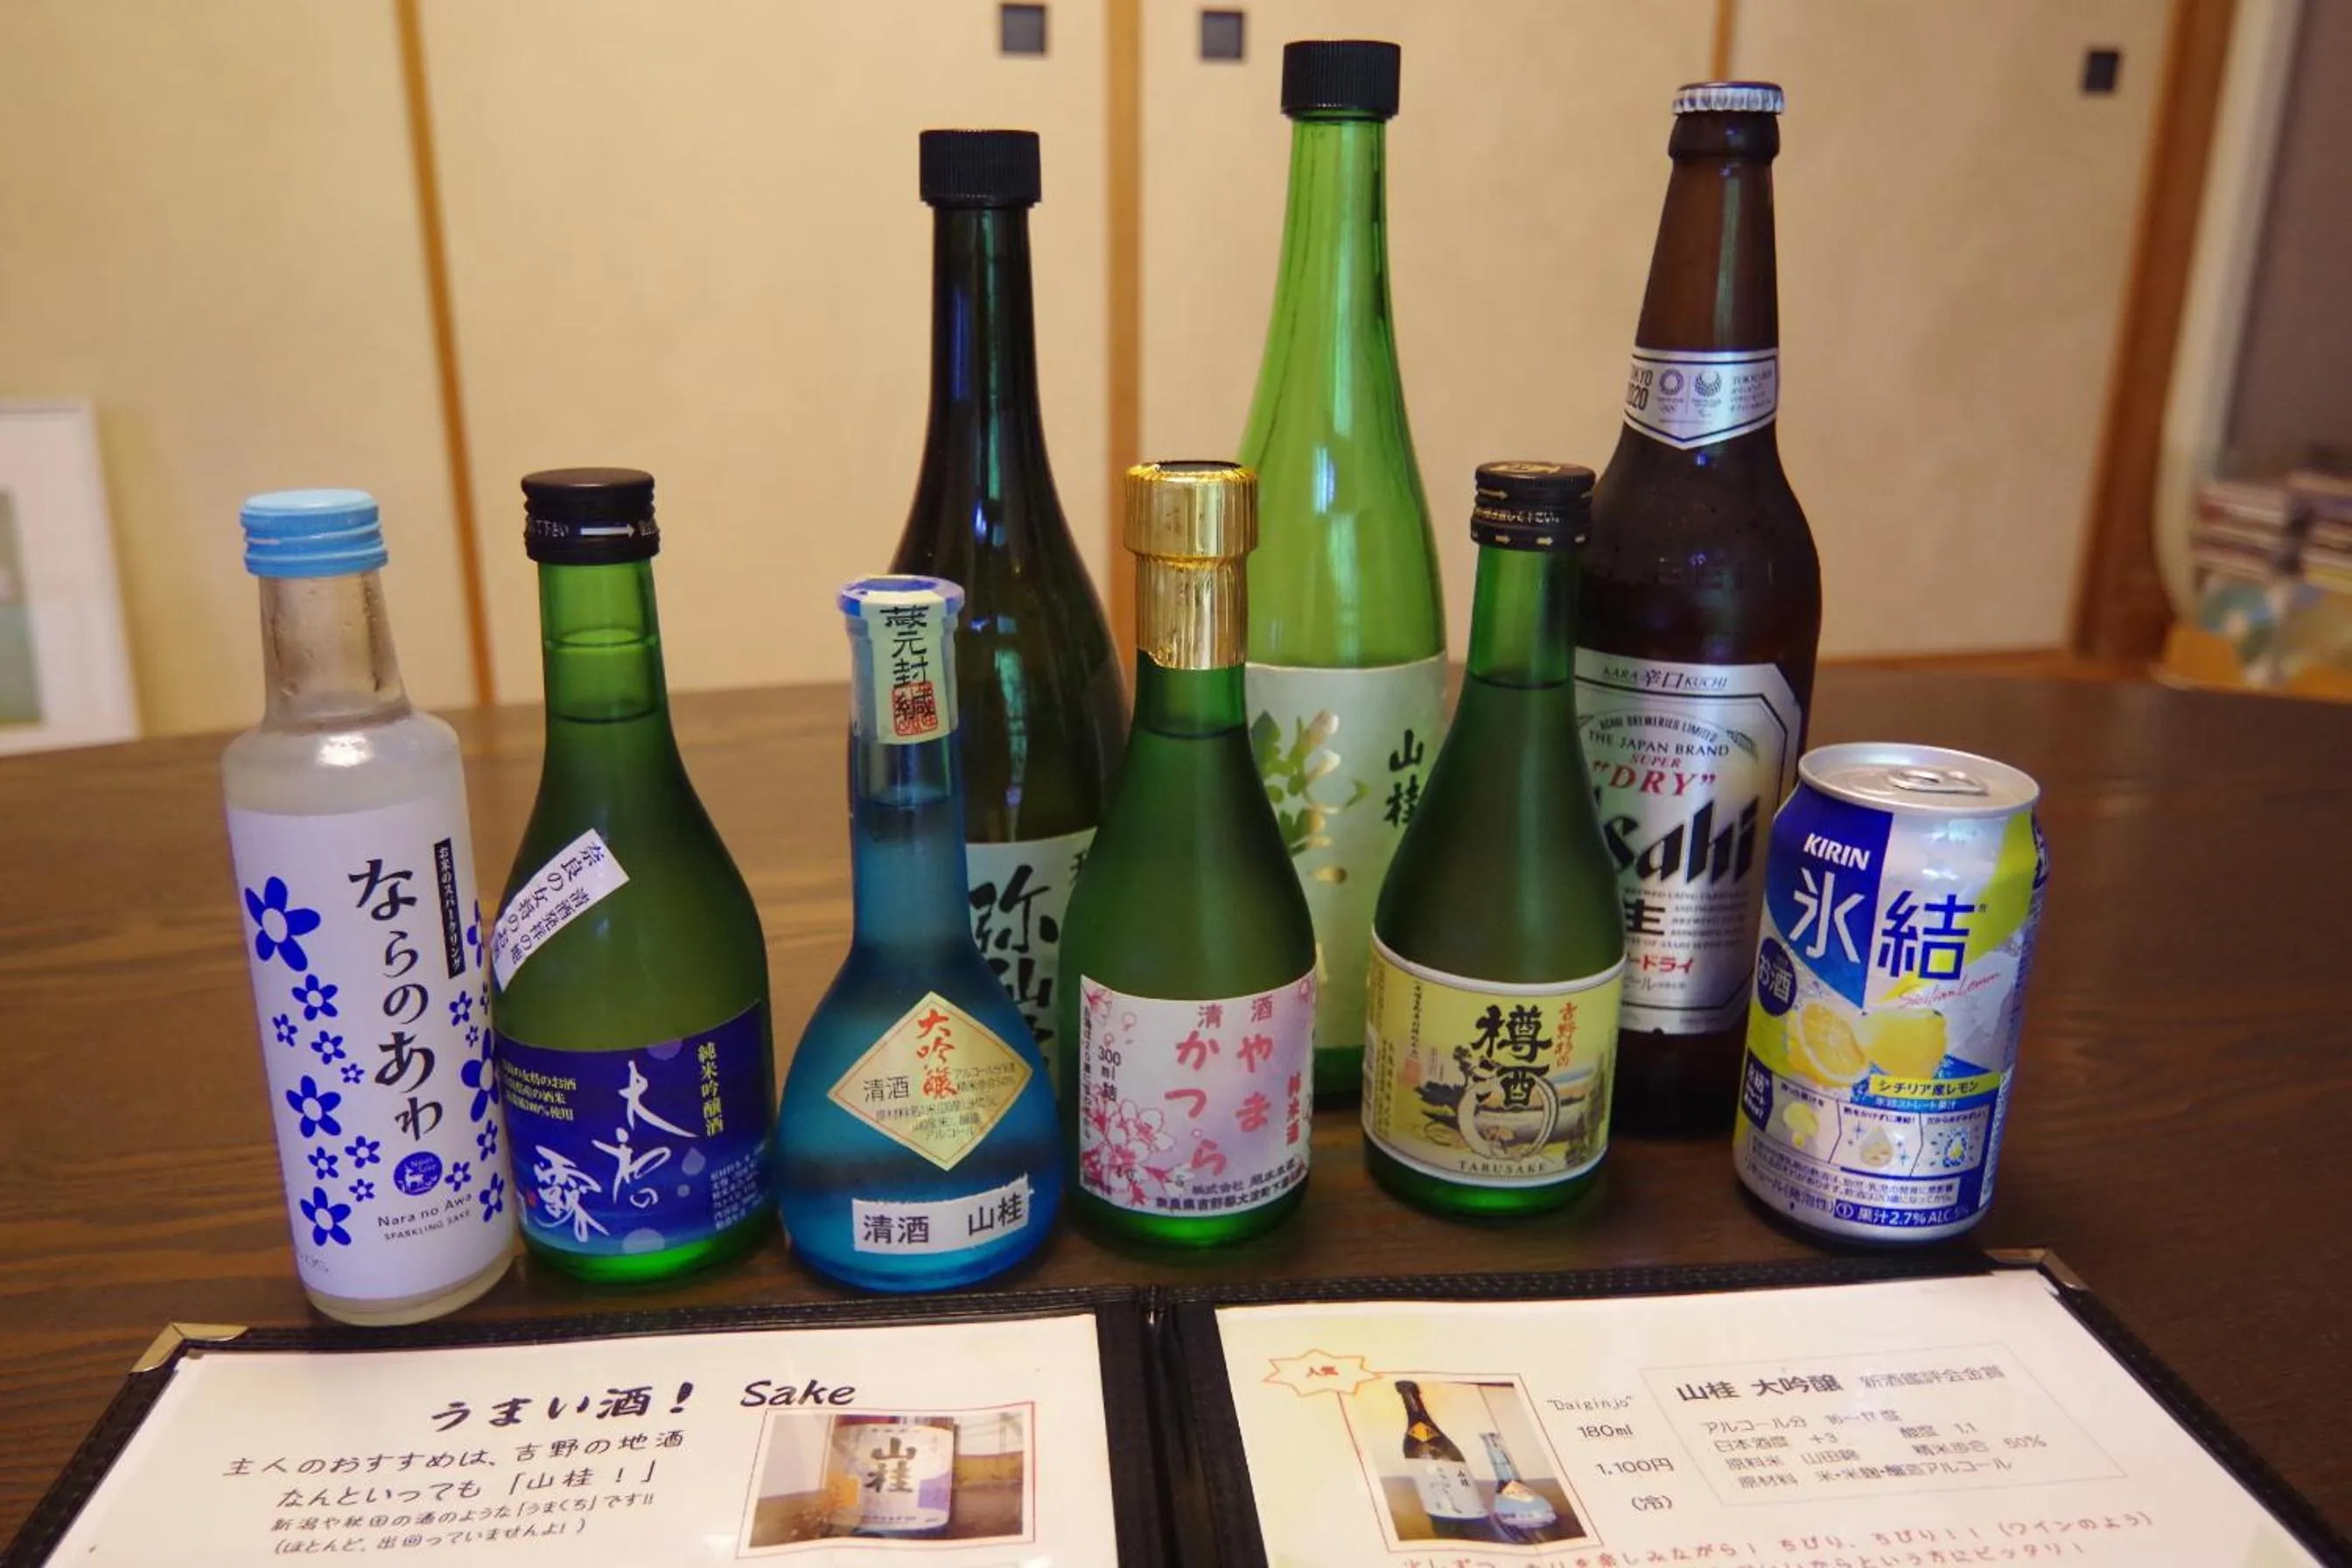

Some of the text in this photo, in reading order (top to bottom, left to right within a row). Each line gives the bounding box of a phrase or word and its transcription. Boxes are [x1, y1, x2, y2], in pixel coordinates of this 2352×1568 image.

[1685, 676, 1727, 688] KUCHI
[1589, 728, 1729, 757] THE JAPAN BRAND
[1631, 753, 1682, 768] SUPER
[1596, 785, 1760, 884] sahi
[1803, 831, 1871, 872] KIRIN
[1788, 866, 1975, 981] 氷結
[1628, 951, 1694, 974] ードライ
[1758, 953, 1794, 1004] お酒
[348, 858, 444, 1143] ならのあわ
[1470, 1004, 1553, 1107] 樽酒
[697, 1041, 724, 1138] 純米吟醸酒
[862, 1075, 911, 1102] 清酒
[1878, 1081, 1980, 1096] シチリア産レモン
[1459, 1158, 1546, 1174] TARUSAKE
[376, 1193, 473, 1228] Nara no Awa
[862, 1193, 1025, 1244] 清酒 山桂
[740, 1379, 857, 1408] Sake
[1676, 1381, 1741, 1402] 山桂
[1751, 1373, 1844, 1396] 大吟醸
[1577, 1424, 1634, 1439] 180ml
[863, 1436, 917, 1493] 山桂
